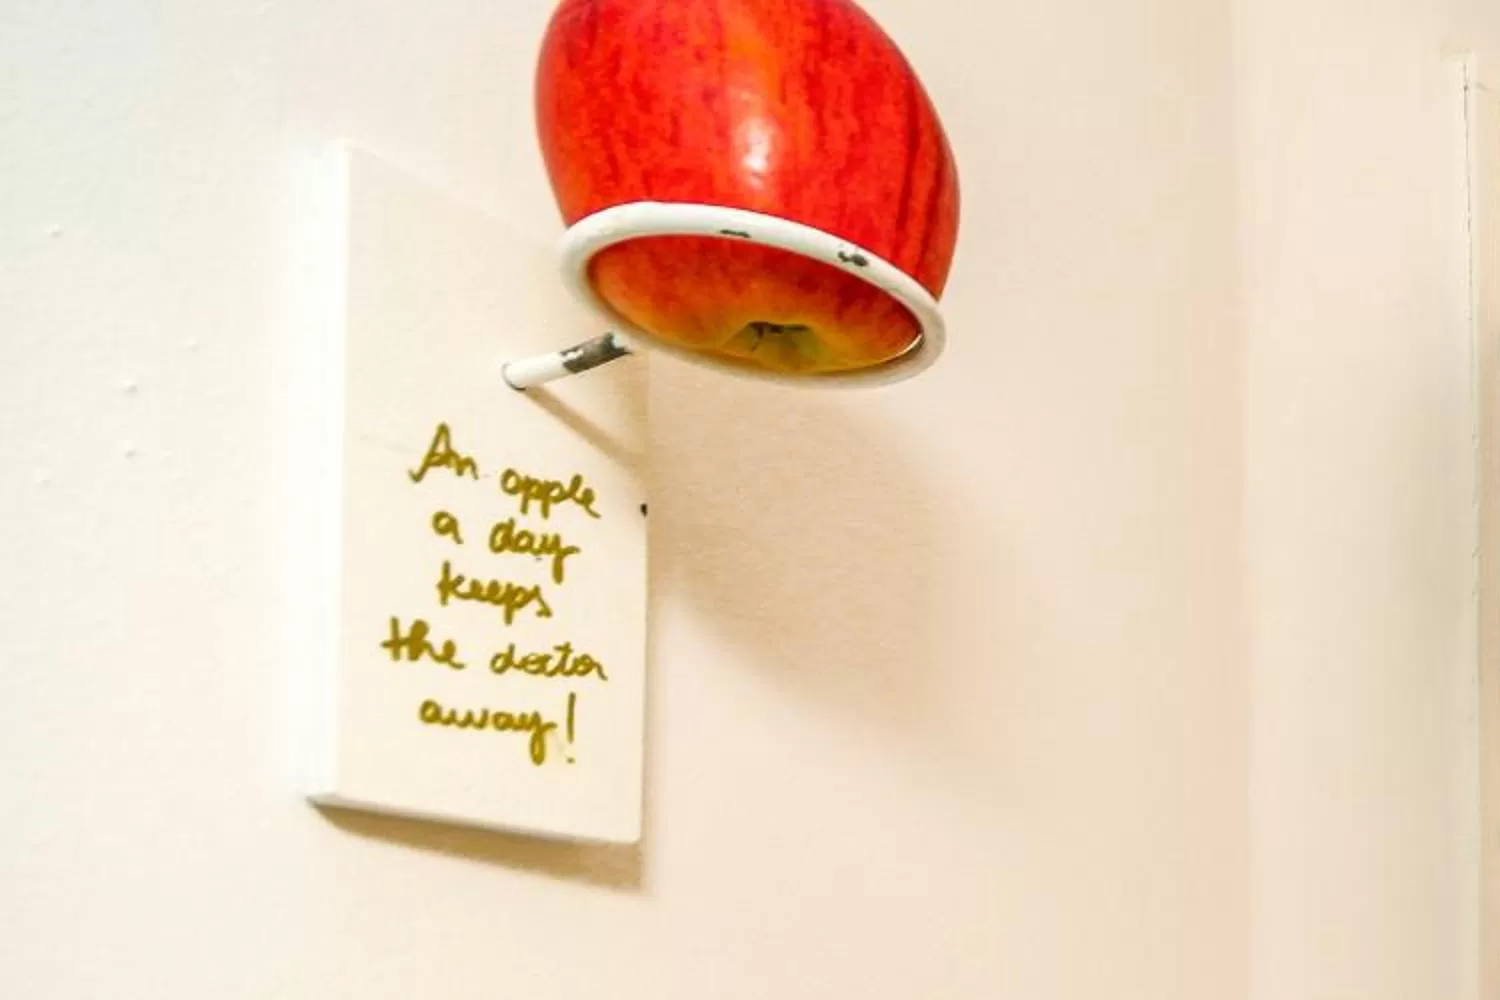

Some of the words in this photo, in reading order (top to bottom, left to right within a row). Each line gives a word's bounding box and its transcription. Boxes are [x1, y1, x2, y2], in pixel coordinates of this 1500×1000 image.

[409, 422, 479, 483] An
[500, 468, 602, 519] apple
[431, 511, 463, 545] a
[488, 517, 581, 585] day
[436, 560, 553, 626] keeps
[380, 616, 466, 670] the
[489, 641, 608, 681] doctor
[418, 691, 577, 767] away!
